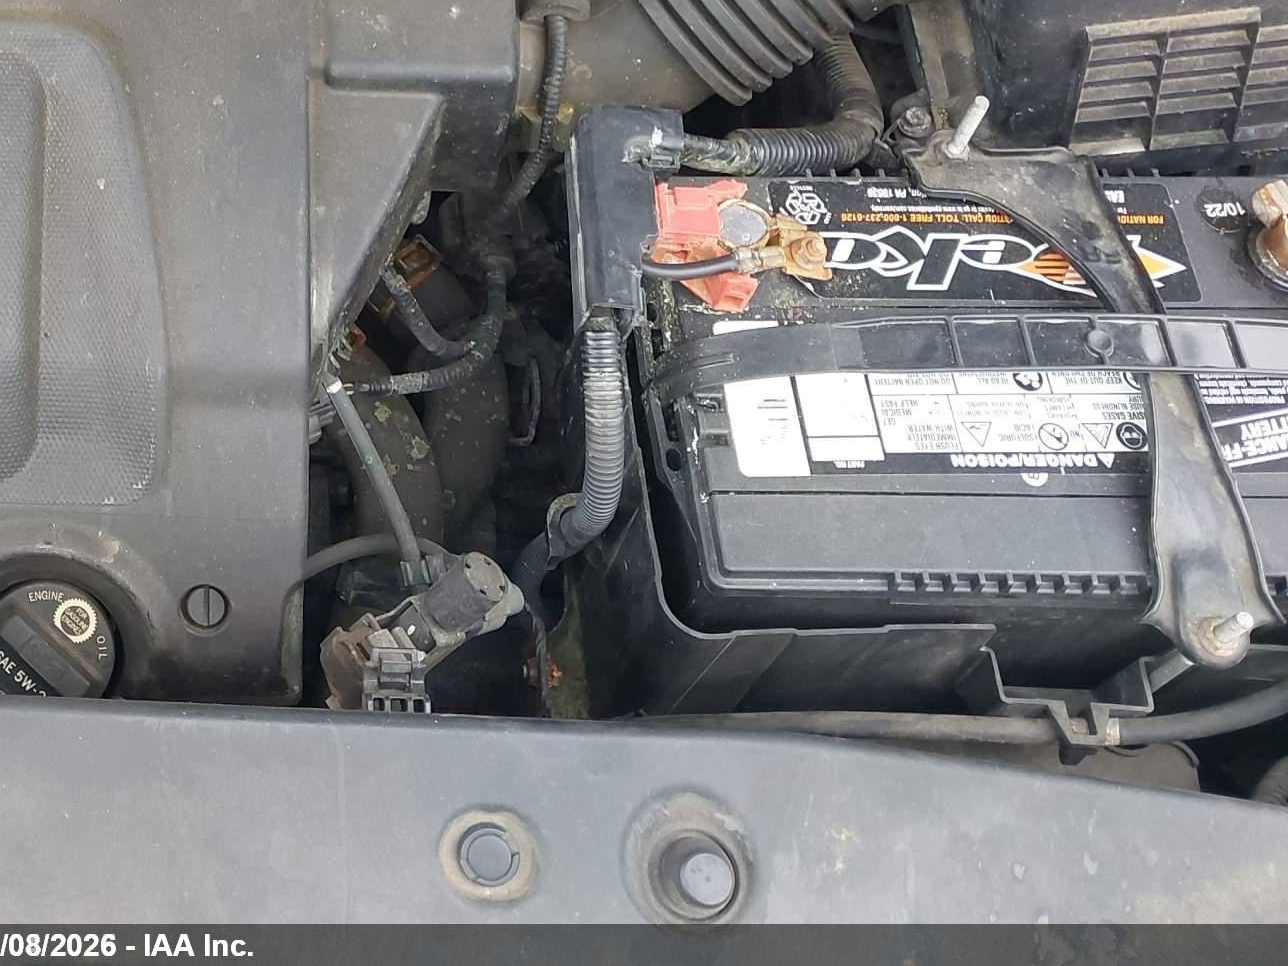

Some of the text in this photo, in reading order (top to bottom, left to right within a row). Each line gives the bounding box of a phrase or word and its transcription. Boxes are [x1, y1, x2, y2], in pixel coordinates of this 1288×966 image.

[1204, 201, 1246, 216] 10/22
[911, 213, 934, 222] FREE
[935, 214, 960, 223] TOLL
[961, 213, 984, 223] CALL:
[1147, 215, 1164, 224] FOR
[1102, 411, 1144, 420] SIVE GASES
[883, 417, 896, 426] GET
[1240, 416, 1288, 440] TTERY
[935, 442, 959, 450] FLUSH
[950, 453, 1099, 468] DANGER/POISON
[28, 590, 65, 603] ENGINE
[96, 635, 108, 660] OIL
